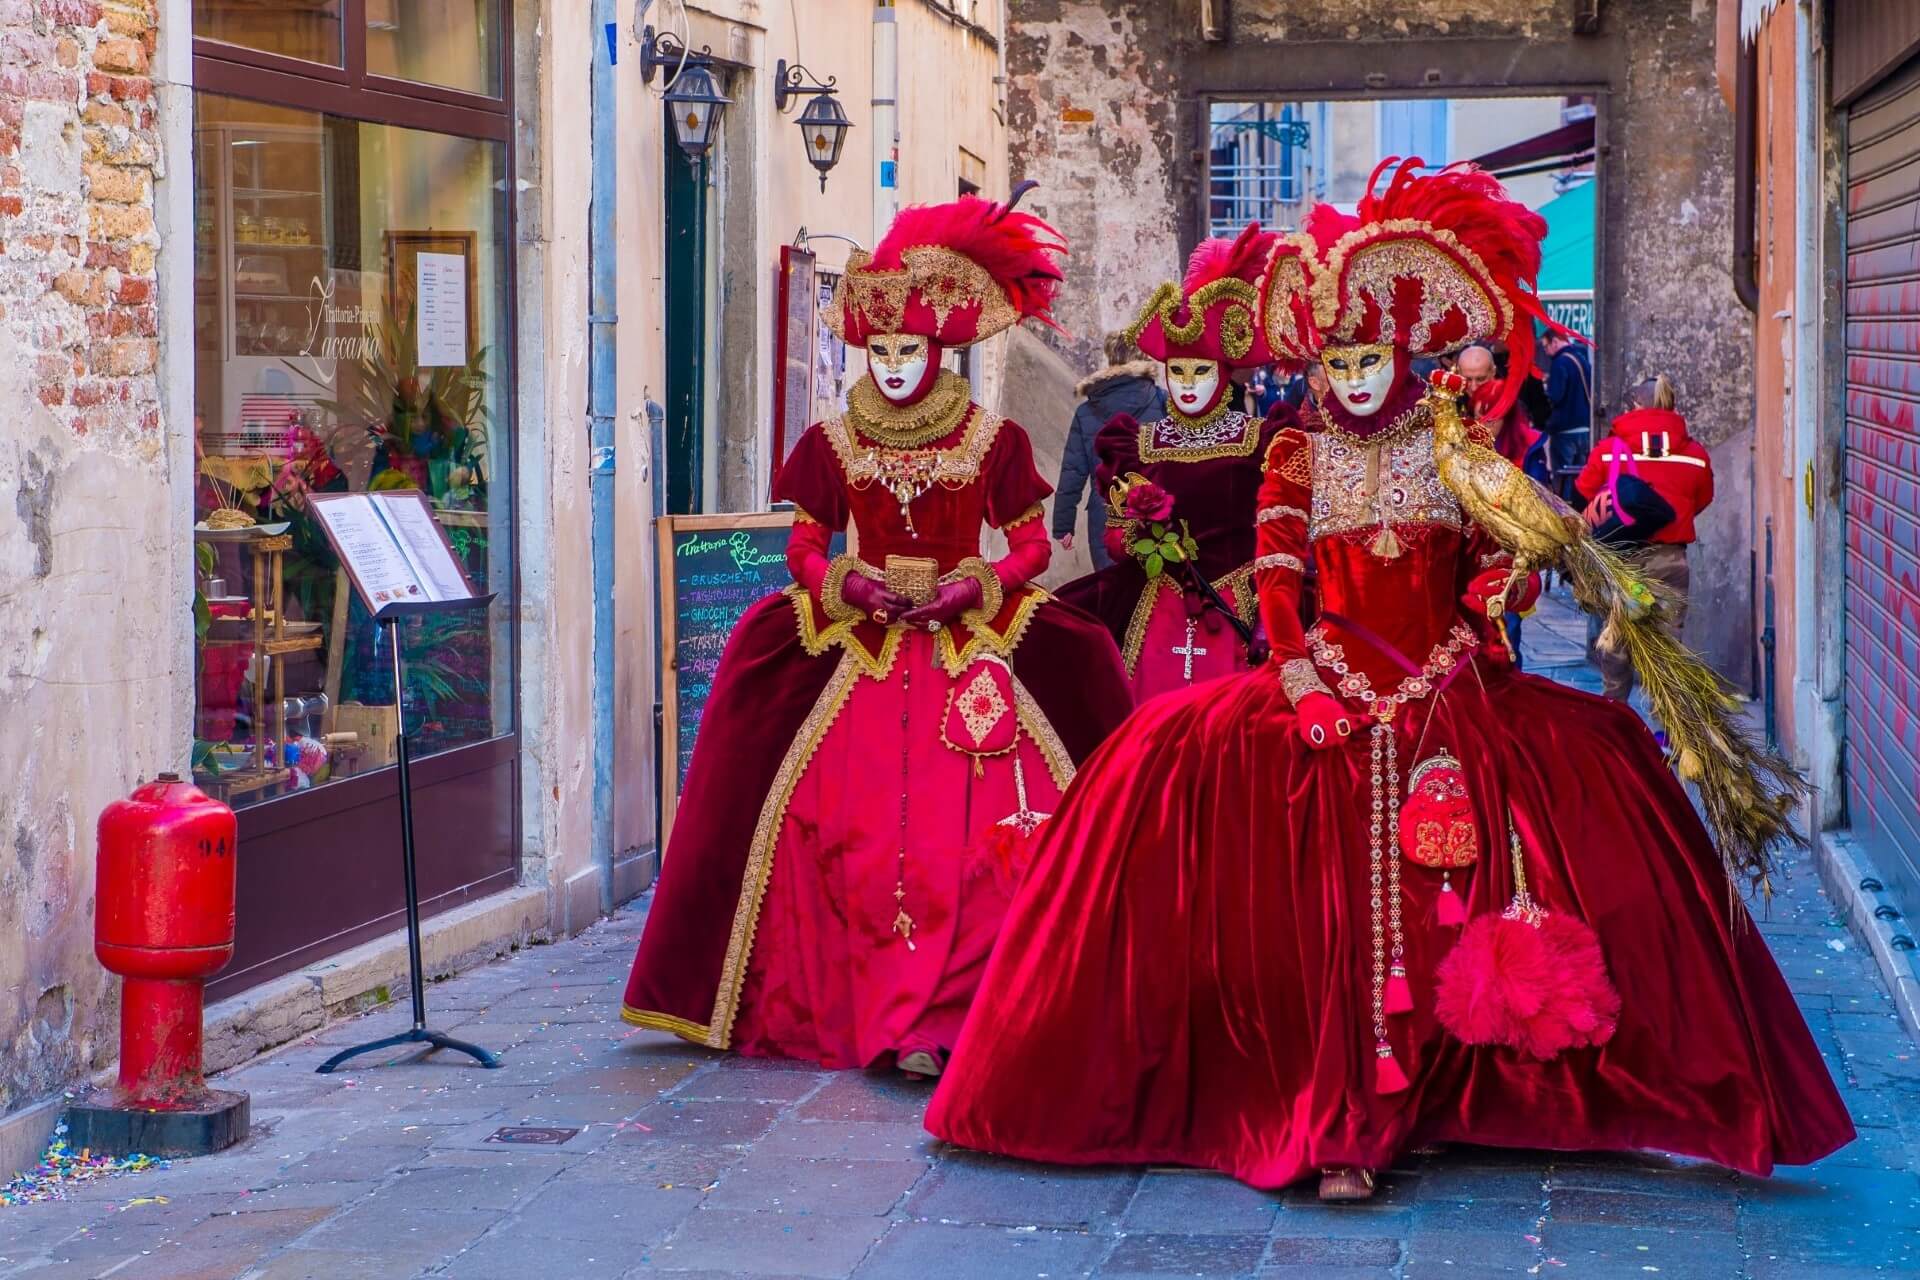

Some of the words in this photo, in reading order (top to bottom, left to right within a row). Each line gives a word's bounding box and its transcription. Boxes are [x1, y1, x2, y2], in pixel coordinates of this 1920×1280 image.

[1547, 303, 1592, 336] PIZZERI
[677, 534, 727, 557] Trattoria
[691, 571, 761, 586] BRUSCHETTA
[690, 606, 728, 622] GNOCCHI
[692, 632, 731, 650] TARTA
